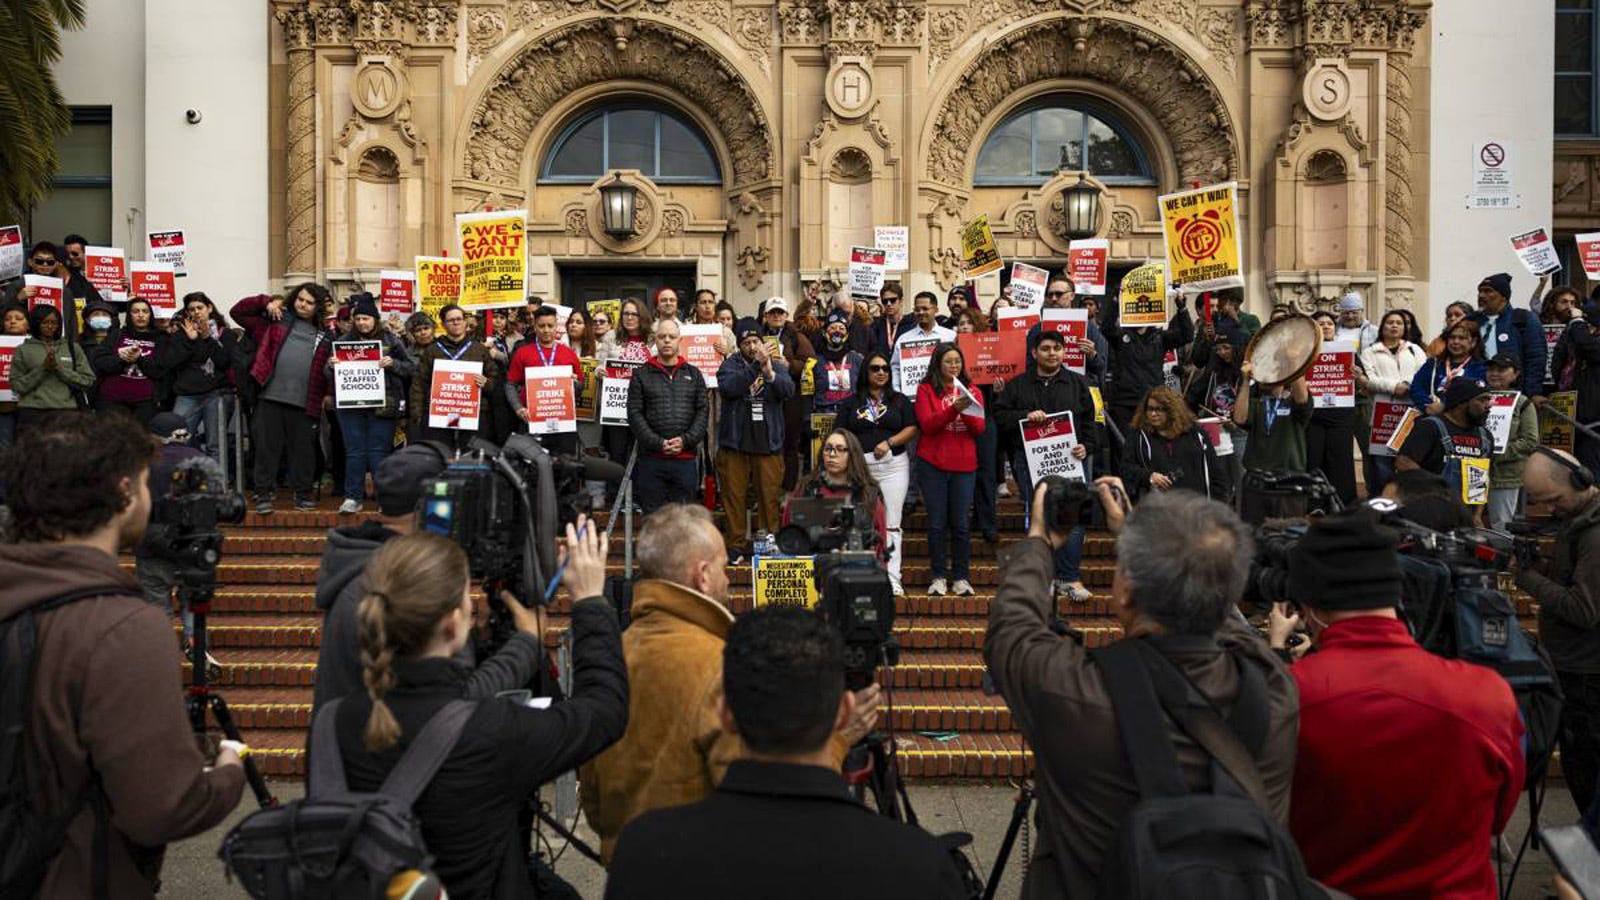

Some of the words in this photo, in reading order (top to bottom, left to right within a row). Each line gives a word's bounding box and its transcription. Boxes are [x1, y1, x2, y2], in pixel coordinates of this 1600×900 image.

[365, 75, 389, 103] M
[842, 76, 861, 102] H
[1320, 78, 1338, 105] S
[1166, 199, 1180, 211] WE
[1181, 193, 1205, 208] CAN'T
[1207, 189, 1228, 202] WAIT
[475, 224, 508, 236] WE
[1190, 233, 1213, 254] UP
[465, 246, 519, 260] WAIT
[94, 265, 119, 273] STRIKE
[433, 264, 460, 274] NO
[1190, 266, 1200, 276] THE
[1201, 262, 1228, 273] SCHOOLS
[1014, 283, 1026, 291] FOR
[34, 298, 56, 306] STRIKE
[1012, 320, 1026, 328] ON
[1056, 324, 1071, 332] ON
[1321, 354, 1337, 362] ON
[1313, 364, 1344, 373] STRIKE
[449, 373, 465, 381] ON
[341, 383, 380, 391] SCHOOLS
[440, 384, 472, 392] STRIKE
[536, 390, 565, 398] STRIKE
[606, 401, 627, 409] SCHO
[1032, 446, 1049, 455] FOR
[1051, 441, 1070, 451] SAFE
[1456, 446, 1480, 455] CHILD
[1043, 451, 1062, 460] AND
[1040, 457, 1069, 469] STABLE
[1037, 464, 1076, 477] SCHOOLS
[758, 570, 797, 579] ESCUELAS
[767, 579, 807, 588] PERSONAL
[765, 589, 808, 598] COMPLETO
